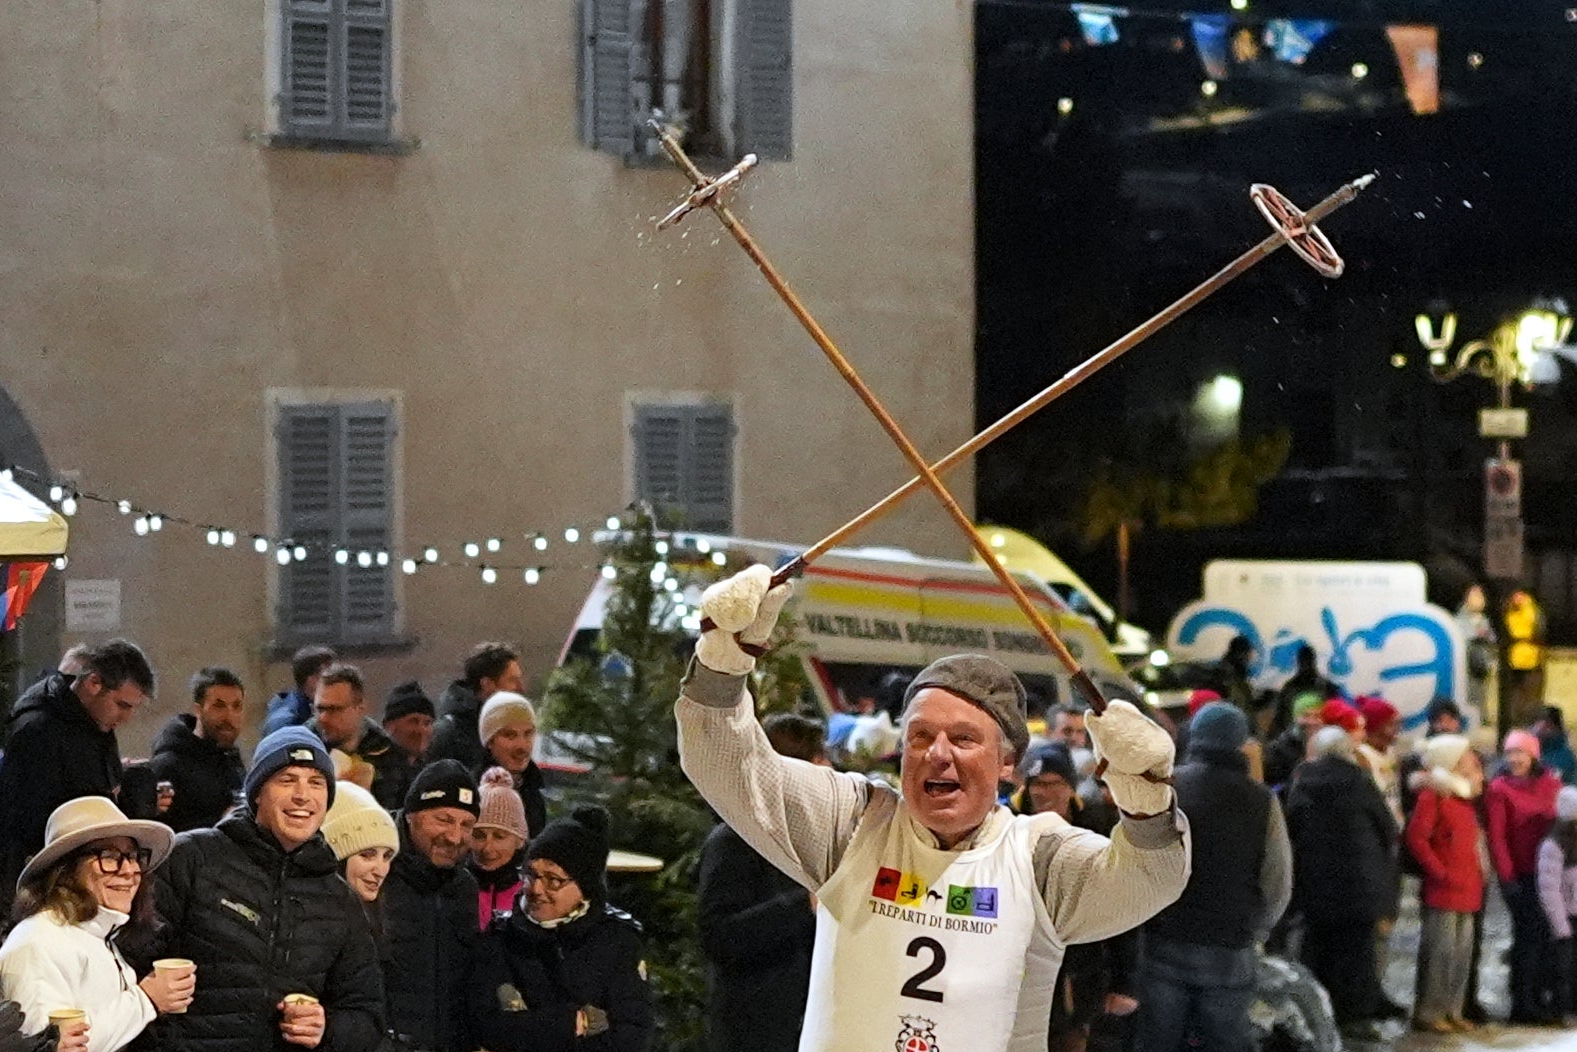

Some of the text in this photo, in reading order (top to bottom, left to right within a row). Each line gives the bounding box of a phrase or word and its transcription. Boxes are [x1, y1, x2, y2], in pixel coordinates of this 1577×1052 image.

[805, 613, 902, 642] VALTELLINA
[878, 903, 926, 926] REPARTI
[930, 915, 942, 928] DI
[945, 918, 998, 934] BORMIO"
[901, 936, 946, 1003] 2
